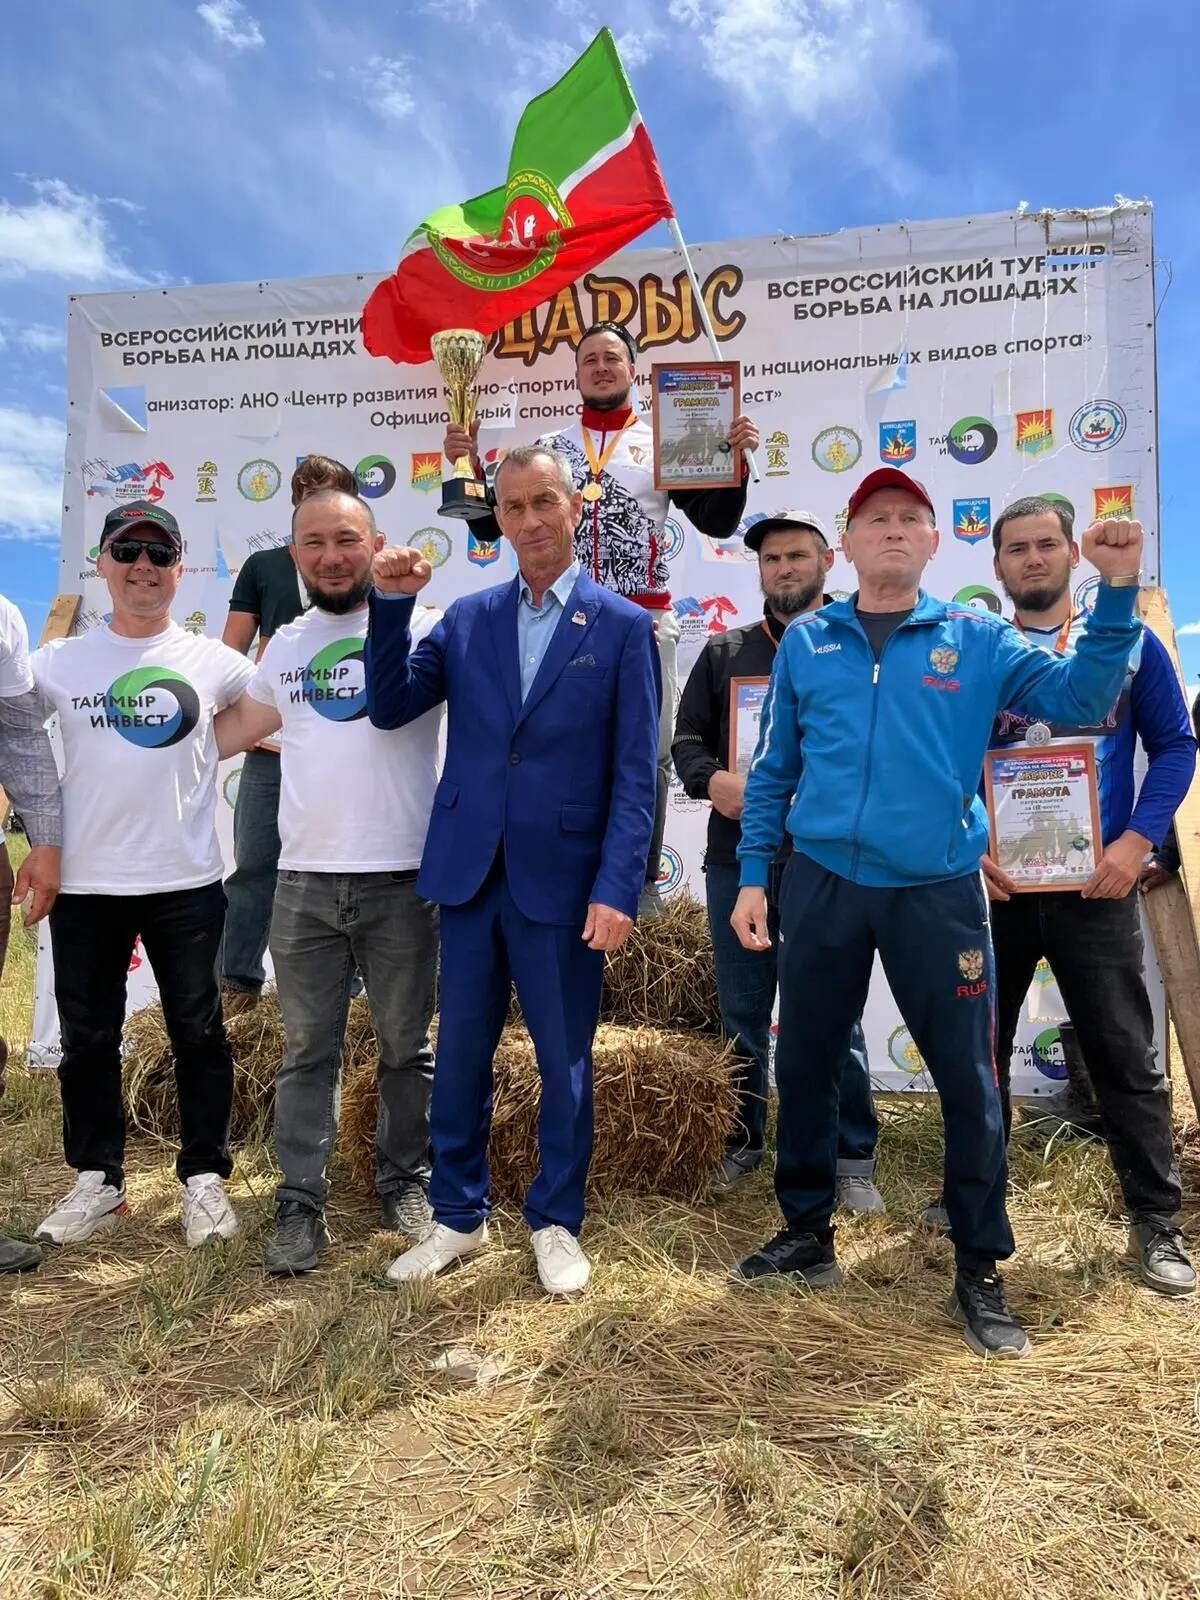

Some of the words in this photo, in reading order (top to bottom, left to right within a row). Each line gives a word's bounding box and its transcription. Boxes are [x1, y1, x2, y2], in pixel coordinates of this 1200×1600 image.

[768, 257, 994, 300] ВСЕРОССИЙСКИЙ
[794, 296, 892, 321] БОРЬБА
[900, 292, 934, 311] НА
[940, 276, 1077, 307] ЛОШАДЯХ
[100, 318, 287, 348] ВСЕРОССИЙСКИЙ
[291, 317, 363, 338] ТУРНИ
[122, 348, 206, 367] БОРЬБА
[210, 347, 241, 363] НА
[244, 340, 357, 361] ЛОШАДЯХ
[145, 397, 235, 413] анизатор:
[239, 392, 280, 409] АНО
[283, 390, 348, 409] «Центр
[353, 387, 438, 407] развития
[743, 364, 756, 378] и
[761, 351, 921, 375] национальных
[927, 343, 998, 364] видов
[1004, 332, 1092, 356] спорта»
[370, 403, 512, 429] Официаный
[519, 401, 584, 419] спонсо
[743, 389, 782, 404] ест»
[673, 397, 721, 408] ГРАМОТА
[279, 667, 350, 687] ТАЙМЫР
[922, 675, 961, 692] RUS
[71, 693, 156, 711] ТАЙМЫР
[289, 686, 360, 704] ИНВЕСТ
[90, 714, 169, 729] ИНВЕСТ
[1012, 785, 1071, 800] ГРАМОТА
[956, 982, 988, 998] RUS
